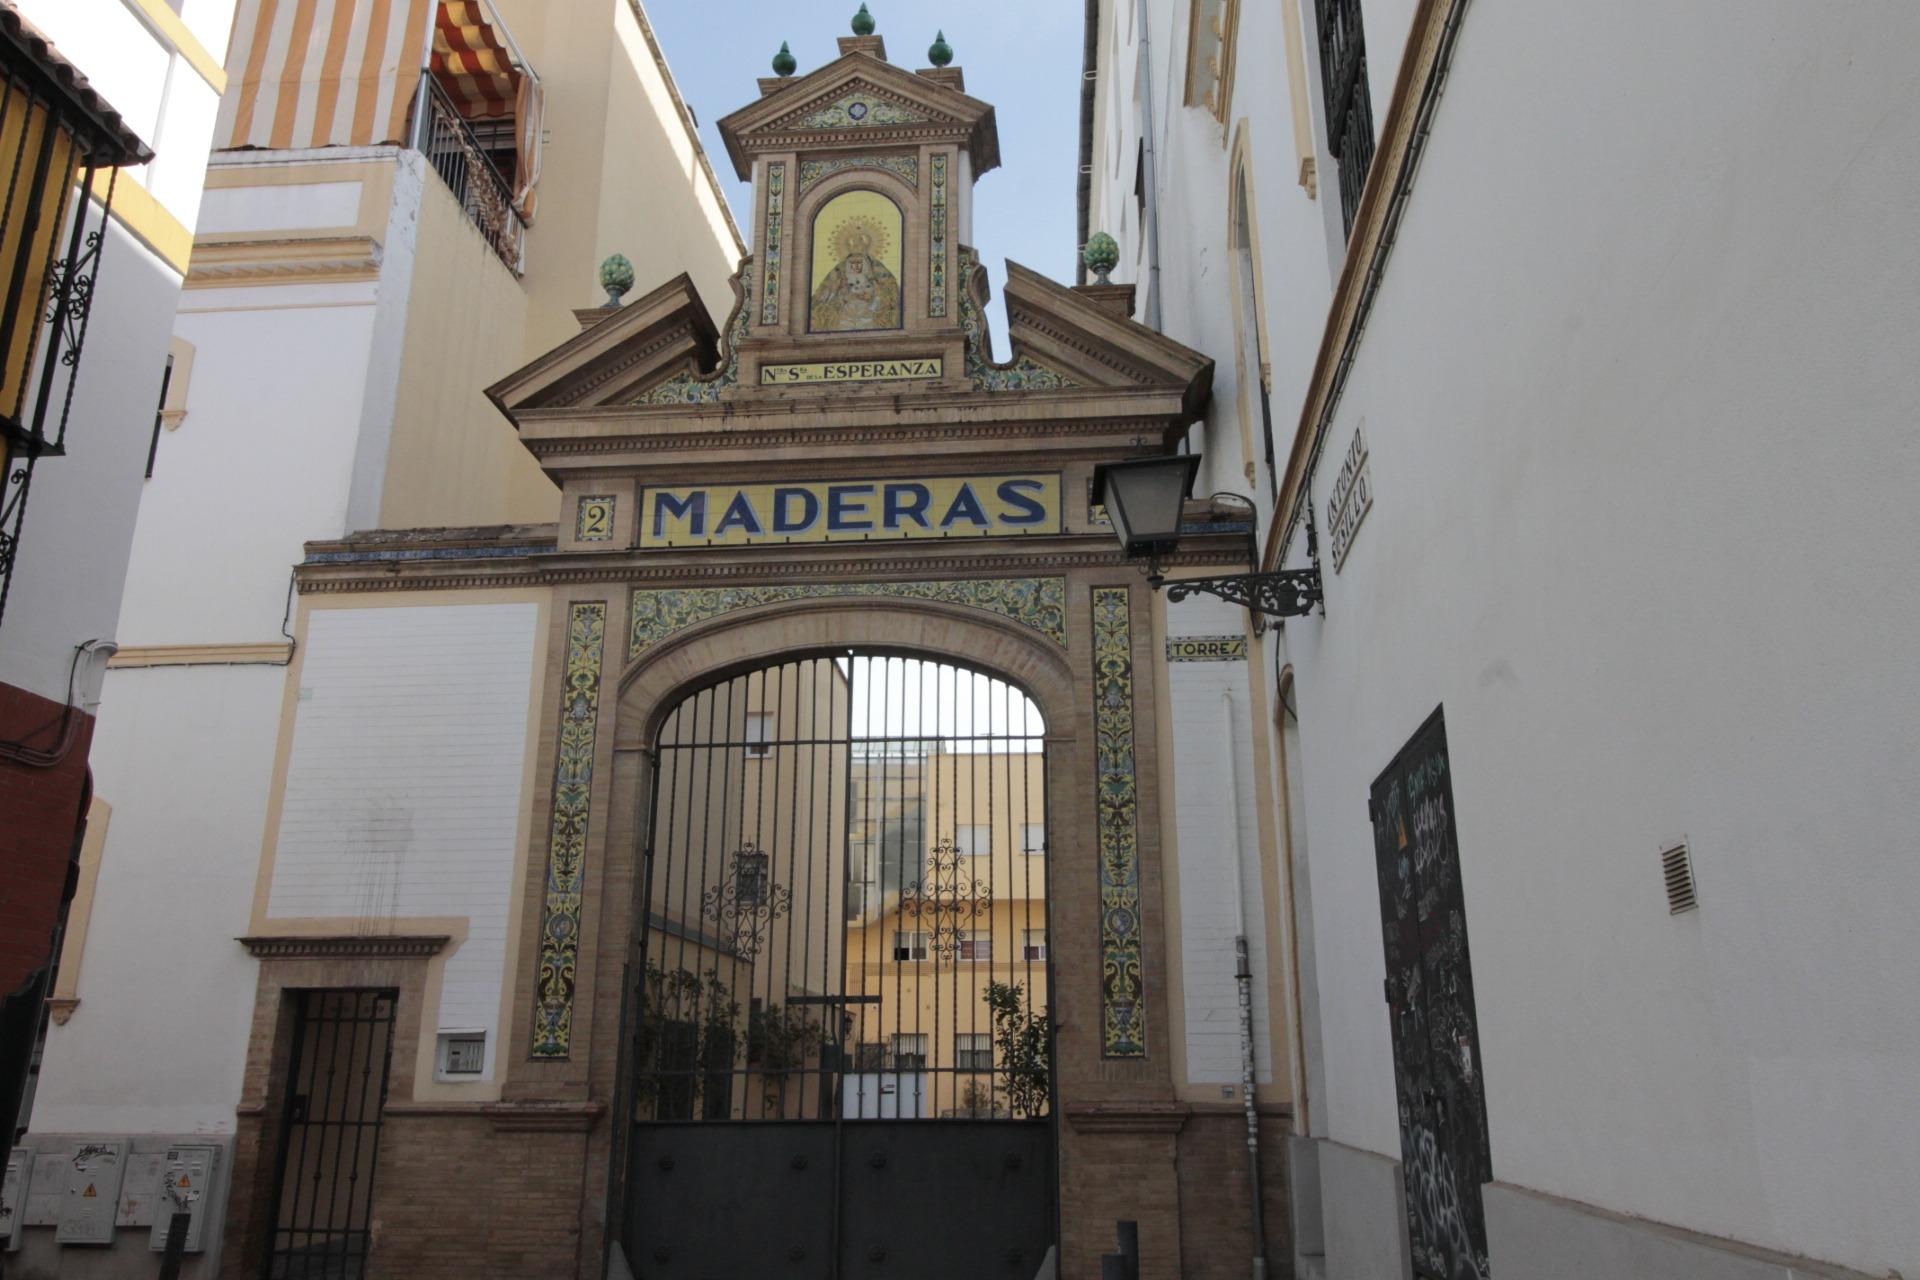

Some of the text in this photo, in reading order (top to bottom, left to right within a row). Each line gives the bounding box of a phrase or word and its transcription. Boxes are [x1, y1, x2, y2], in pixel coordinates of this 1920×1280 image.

[823, 362, 938, 379] ESPERANZA
[1327, 427, 1362, 531] ANTONIO
[586, 505, 606, 534] 2
[652, 480, 1047, 538] MADERAS
